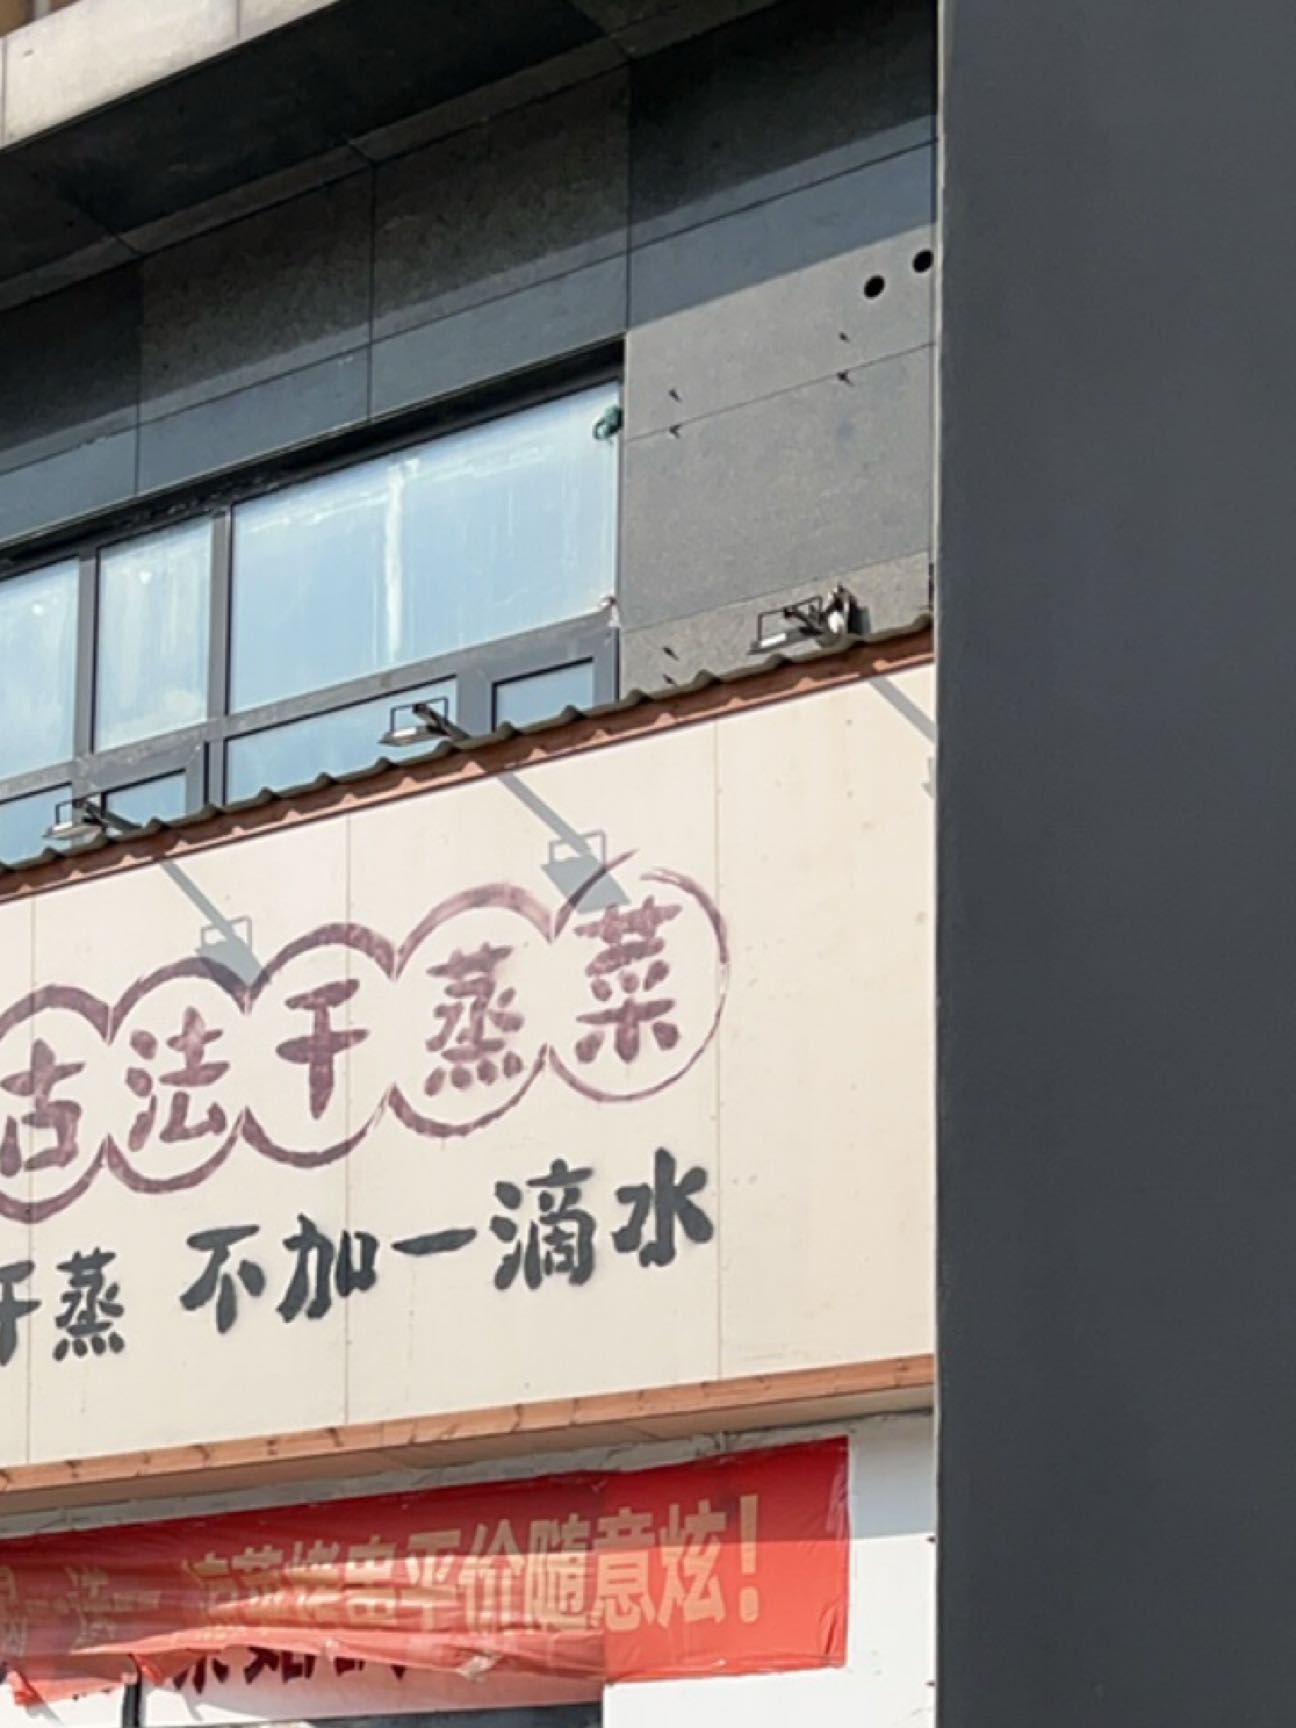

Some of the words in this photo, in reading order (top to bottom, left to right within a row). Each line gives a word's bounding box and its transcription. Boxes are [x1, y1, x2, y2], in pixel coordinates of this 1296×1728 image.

[180, 1146, 714, 1335] 不加一滴水
